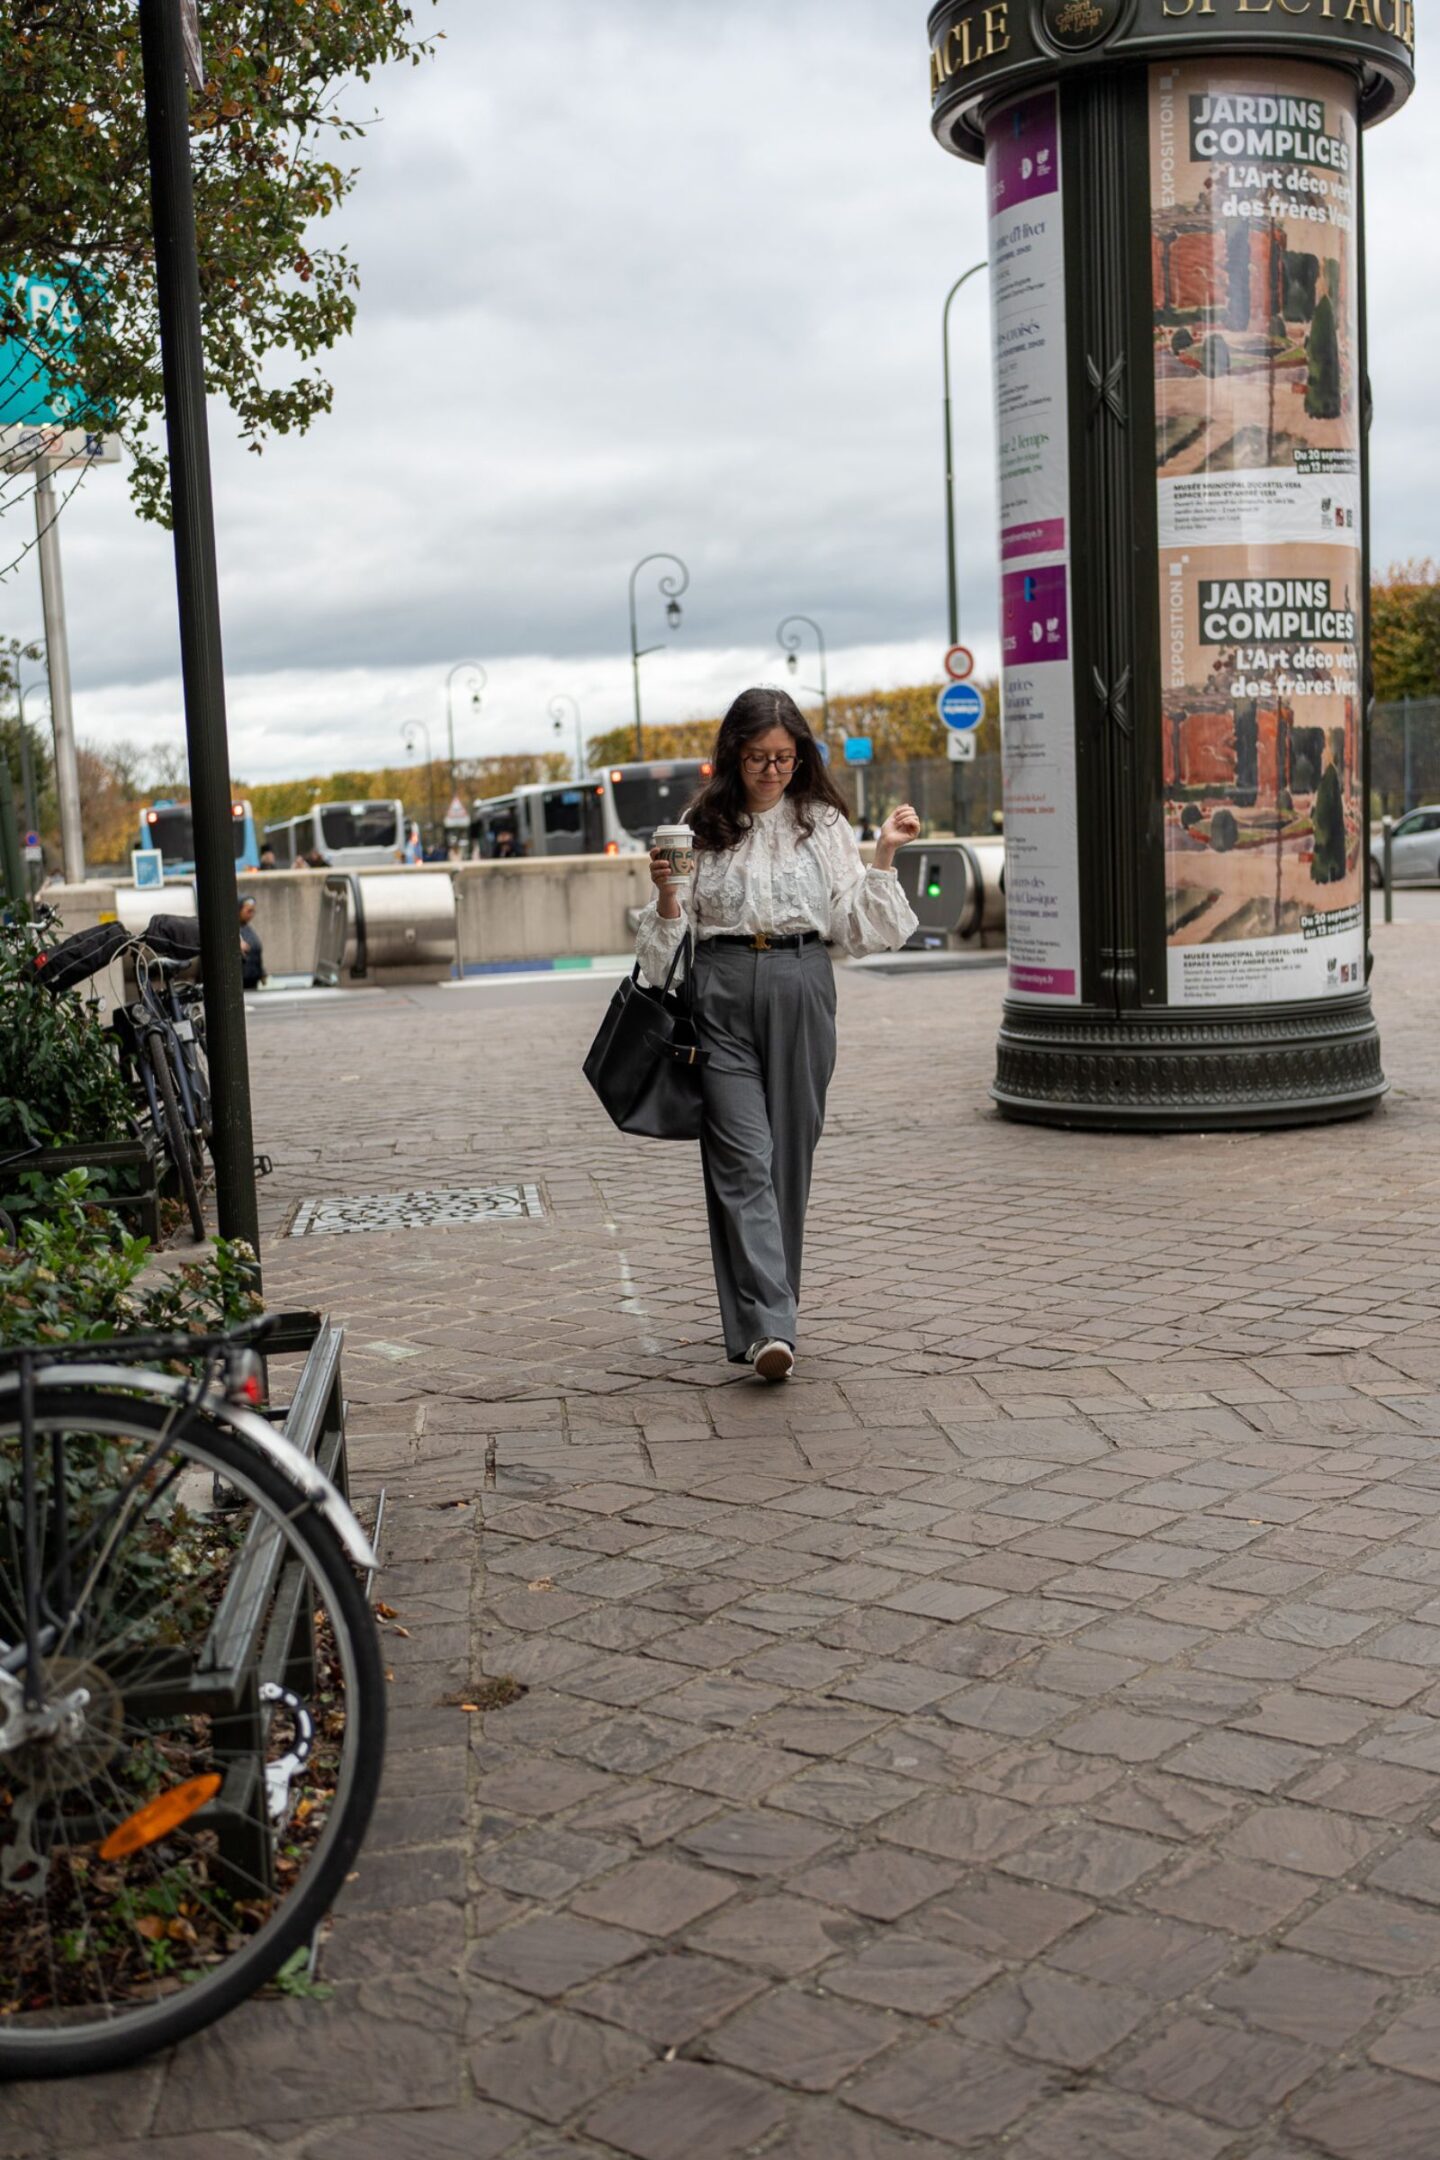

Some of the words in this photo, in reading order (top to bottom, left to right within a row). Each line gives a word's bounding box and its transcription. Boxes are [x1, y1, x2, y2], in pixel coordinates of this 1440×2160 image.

[1194, 97, 1322, 130] JARDINS
[1160, 95, 1175, 208] EXPOSITION
[1195, 128, 1349, 170] COMPLICES
[1286, 168, 1328, 194] déco
[1222, 194, 1265, 217] des
[1269, 198, 1326, 223] frères
[1308, 449, 1321, 461] 20
[1202, 581, 1328, 610] JARDINS
[1169, 580, 1185, 688] EXPOSITION
[1203, 610, 1354, 640] COMPLICES
[1292, 646, 1333, 670] déco
[1230, 676, 1272, 698] des
[1276, 674, 1332, 697] frères
[1314, 913, 1326, 924] 20
[1212, 951, 1254, 959] MUNICIPAL
